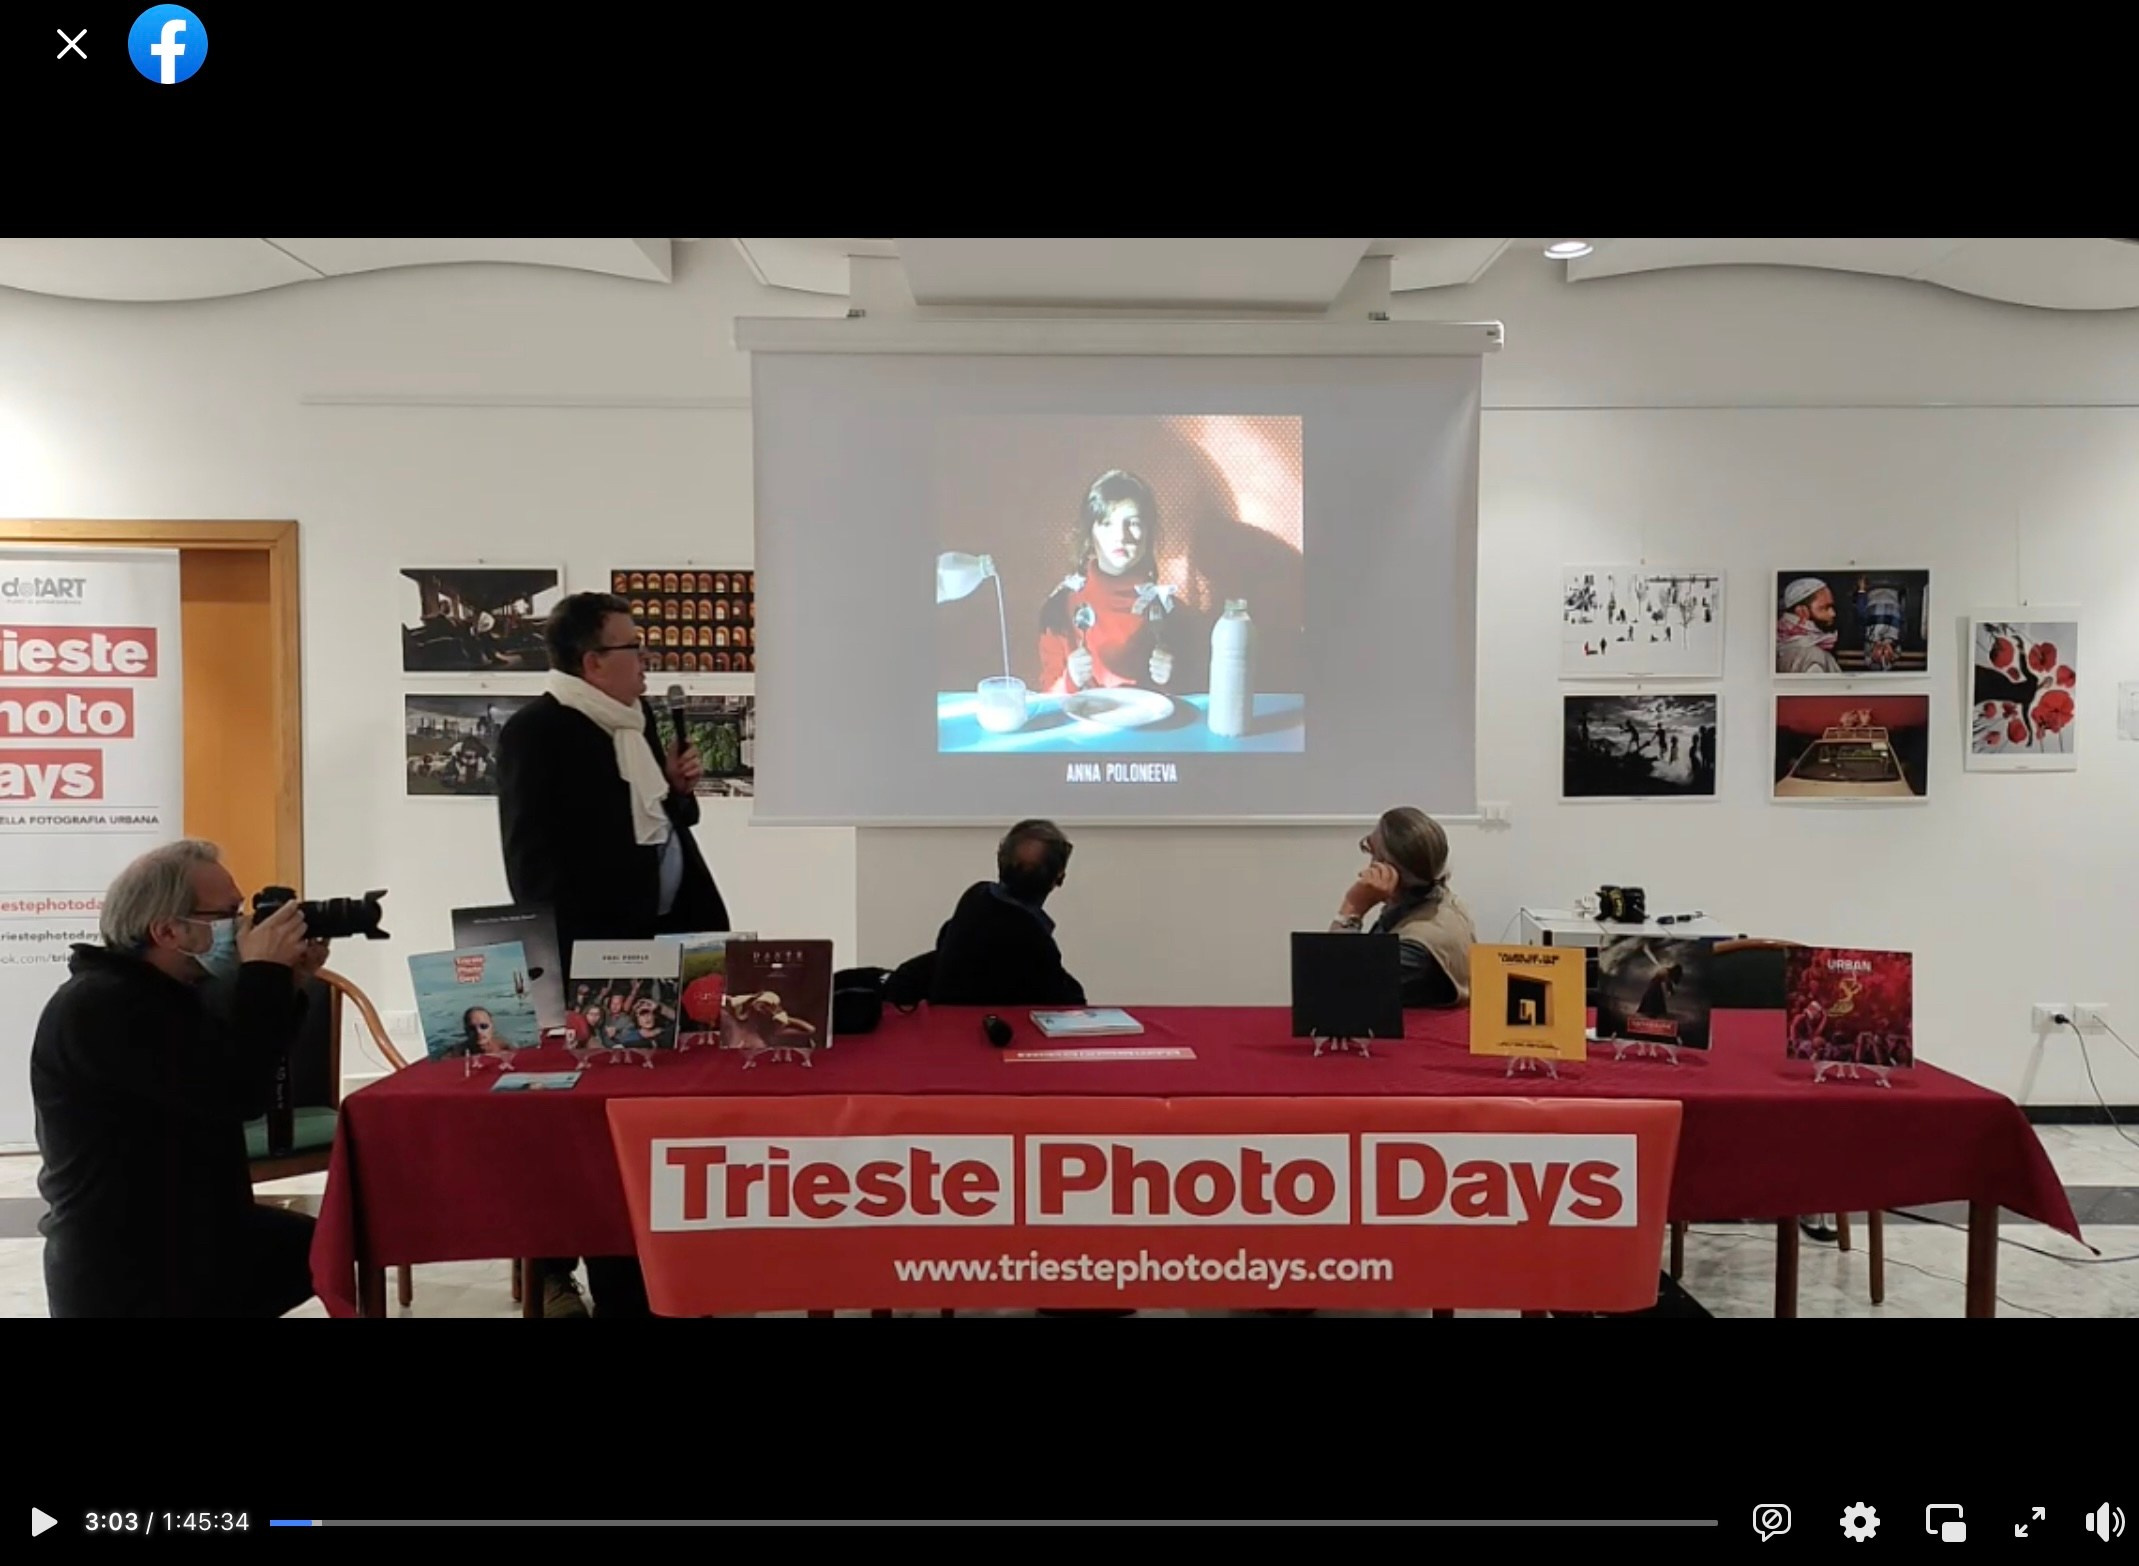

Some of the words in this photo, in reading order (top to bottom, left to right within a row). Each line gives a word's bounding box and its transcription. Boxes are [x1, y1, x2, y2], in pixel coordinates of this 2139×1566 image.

[0, 629, 149, 673] ieste
[1066, 762, 1101, 782] ANNA
[30, 815, 106, 825] FOTOGRAFIA
[110, 815, 160, 825] URBANA
[1827, 958, 1872, 973] URBAN
[665, 1145, 1000, 1220] Trieste
[1039, 1142, 1335, 1216] Photo
[1375, 1141, 1623, 1226] Days
[894, 1249, 1393, 1290] www.triestephotodays.com
